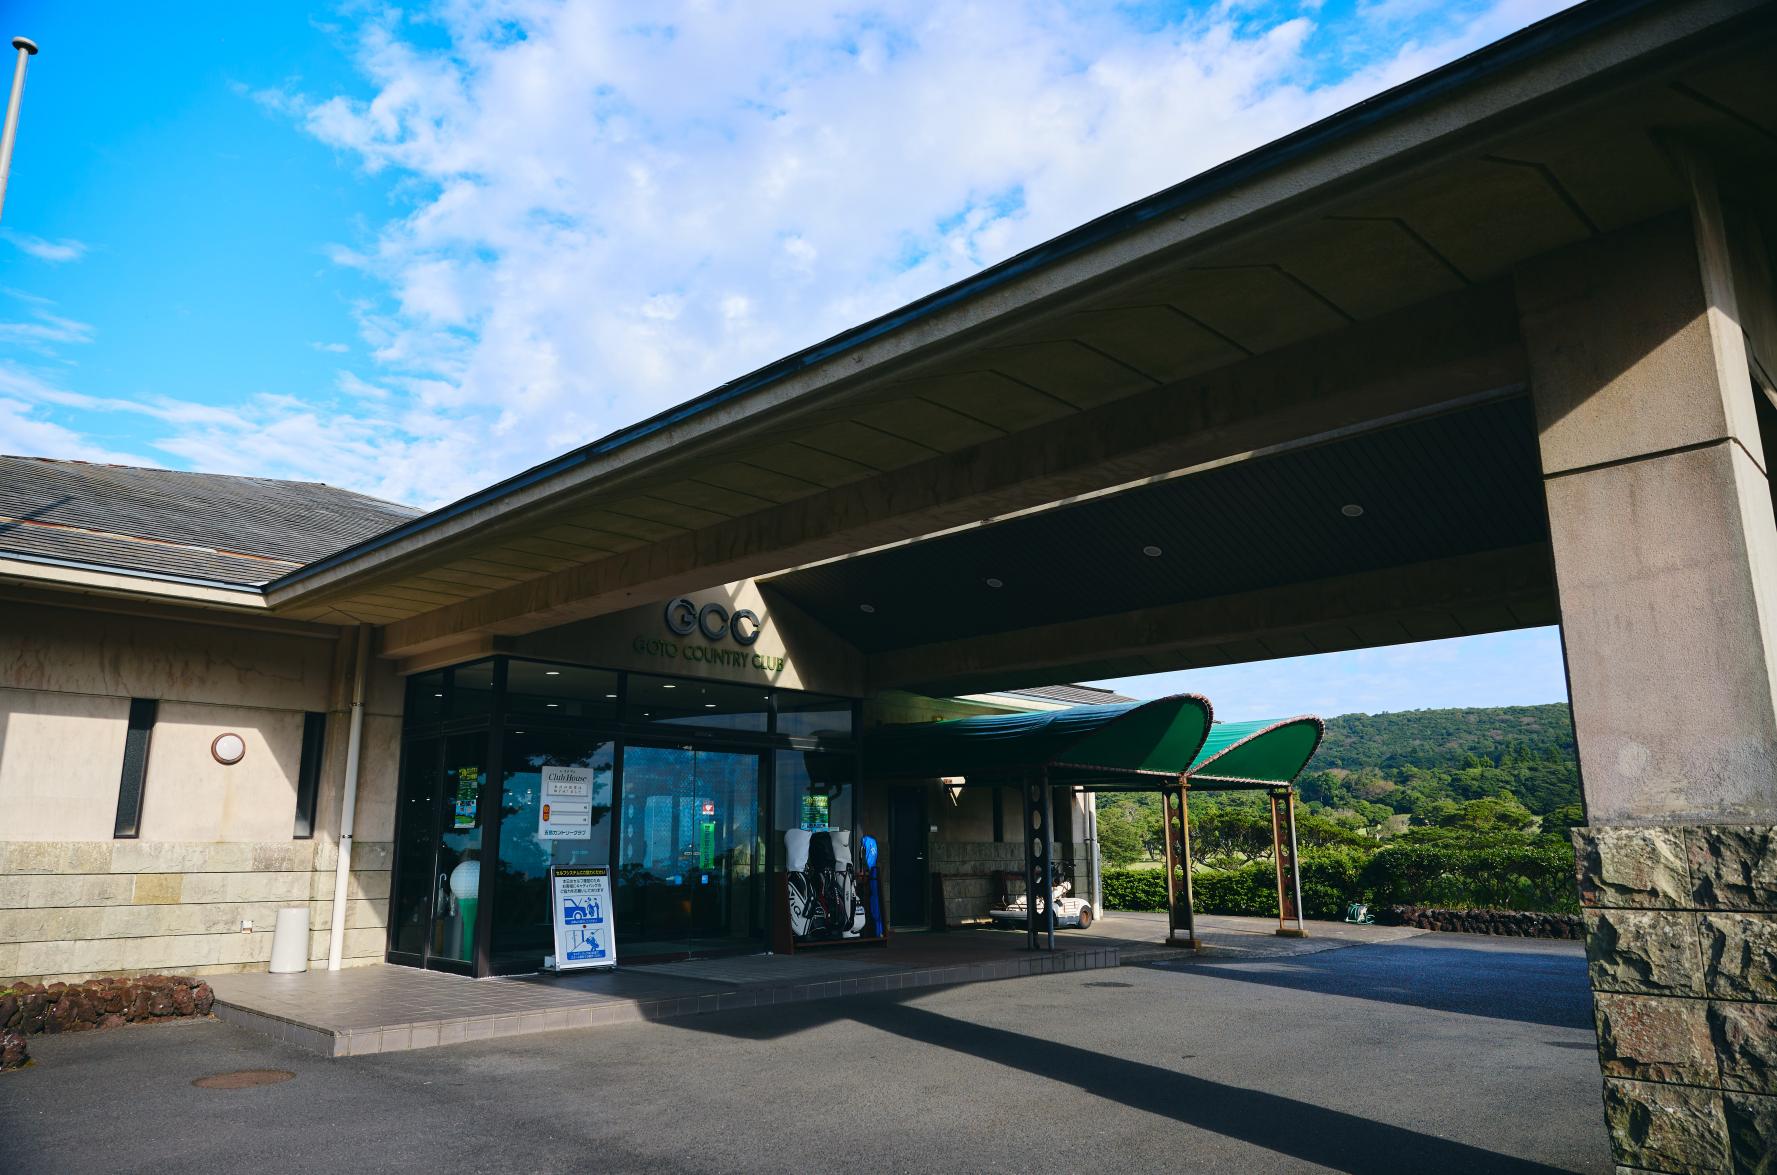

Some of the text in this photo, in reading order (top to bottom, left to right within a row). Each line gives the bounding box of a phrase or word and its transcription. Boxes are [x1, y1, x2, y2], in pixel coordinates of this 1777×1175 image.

[665, 598, 761, 646] GCC
[632, 635, 784, 672] GOTO COUNTRY CLUB
